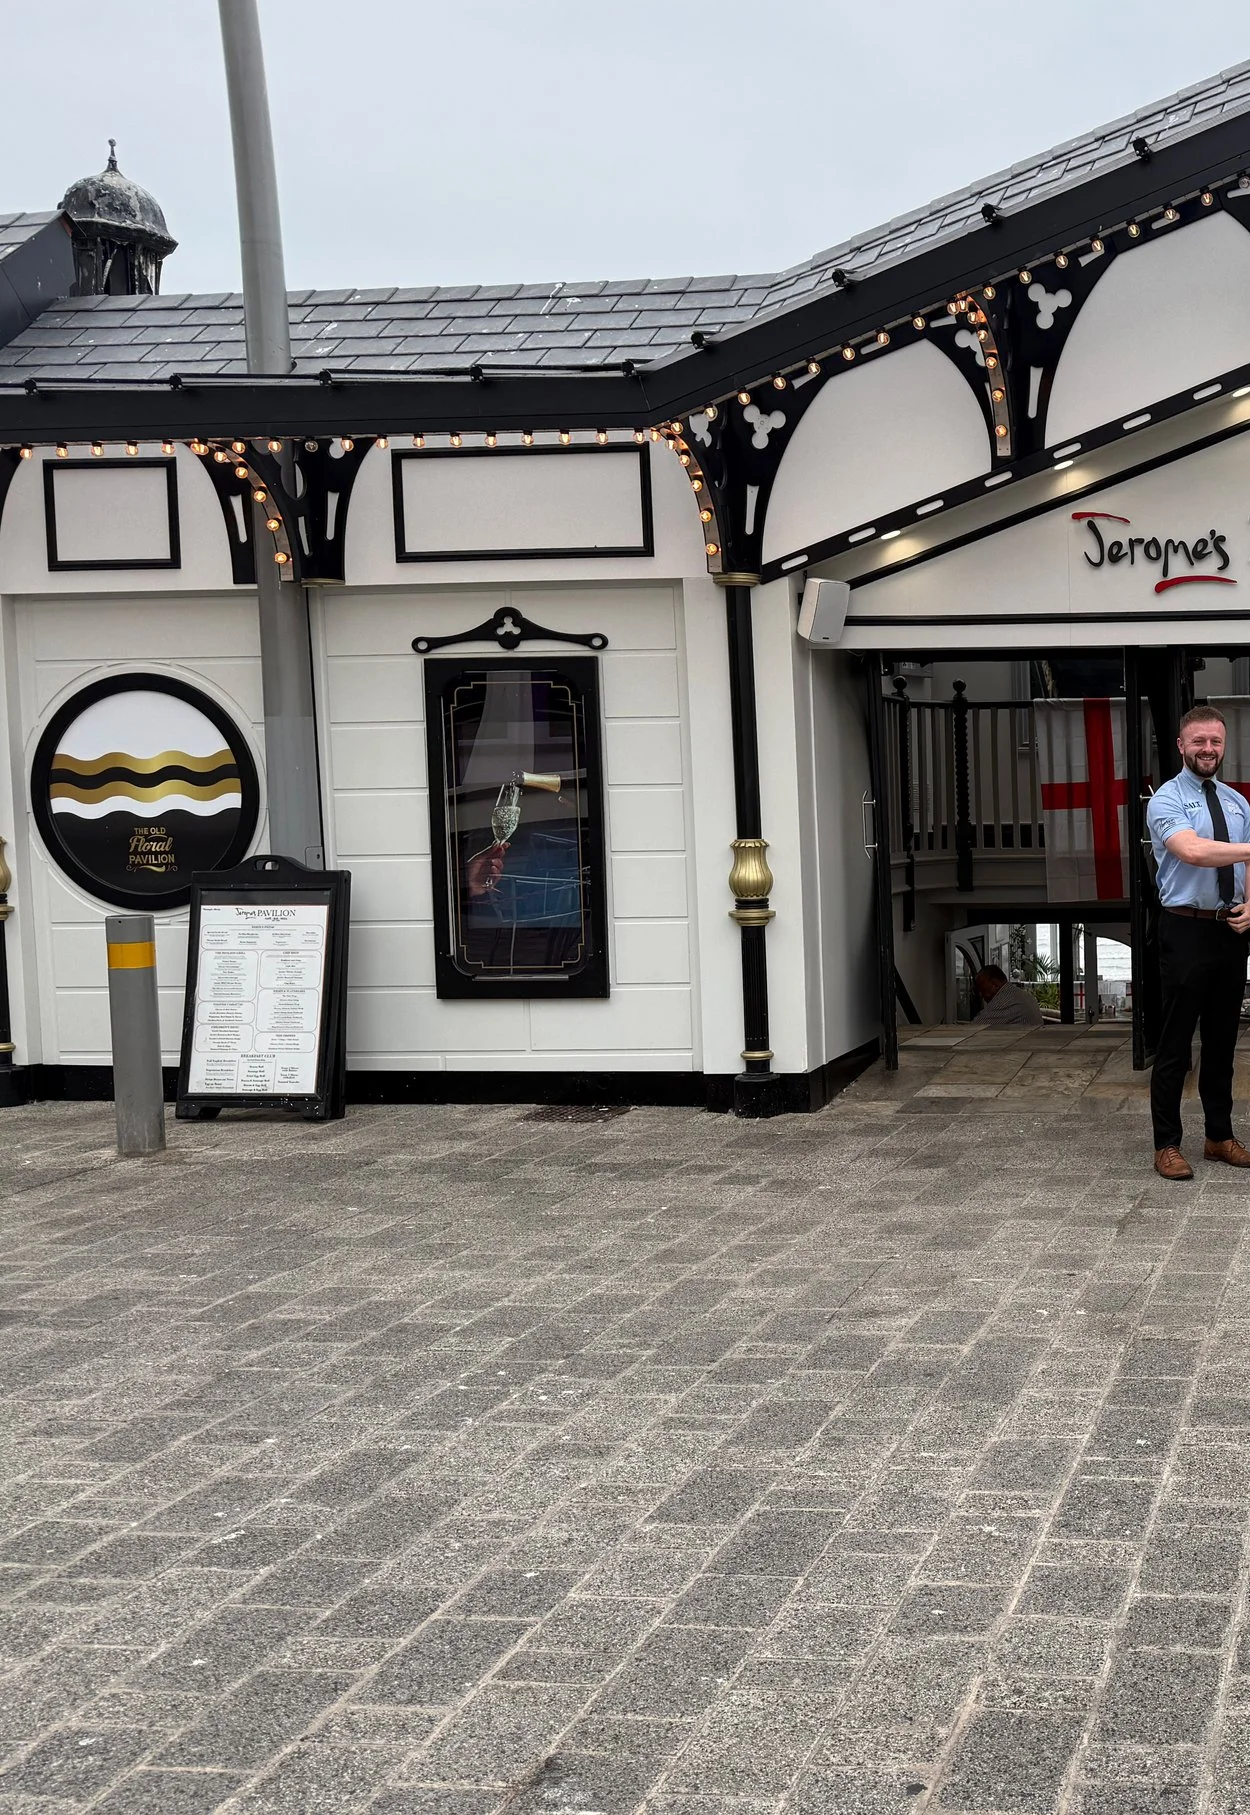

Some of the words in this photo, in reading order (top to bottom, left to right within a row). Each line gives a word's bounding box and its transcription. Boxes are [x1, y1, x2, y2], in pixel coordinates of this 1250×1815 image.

[1072, 512, 1230, 577] Jerome's
[150, 826, 166, 834] OLD
[129, 836, 174, 852] Floral
[128, 854, 175, 864] PAVILION
[257, 909, 296, 917] PAVILION
